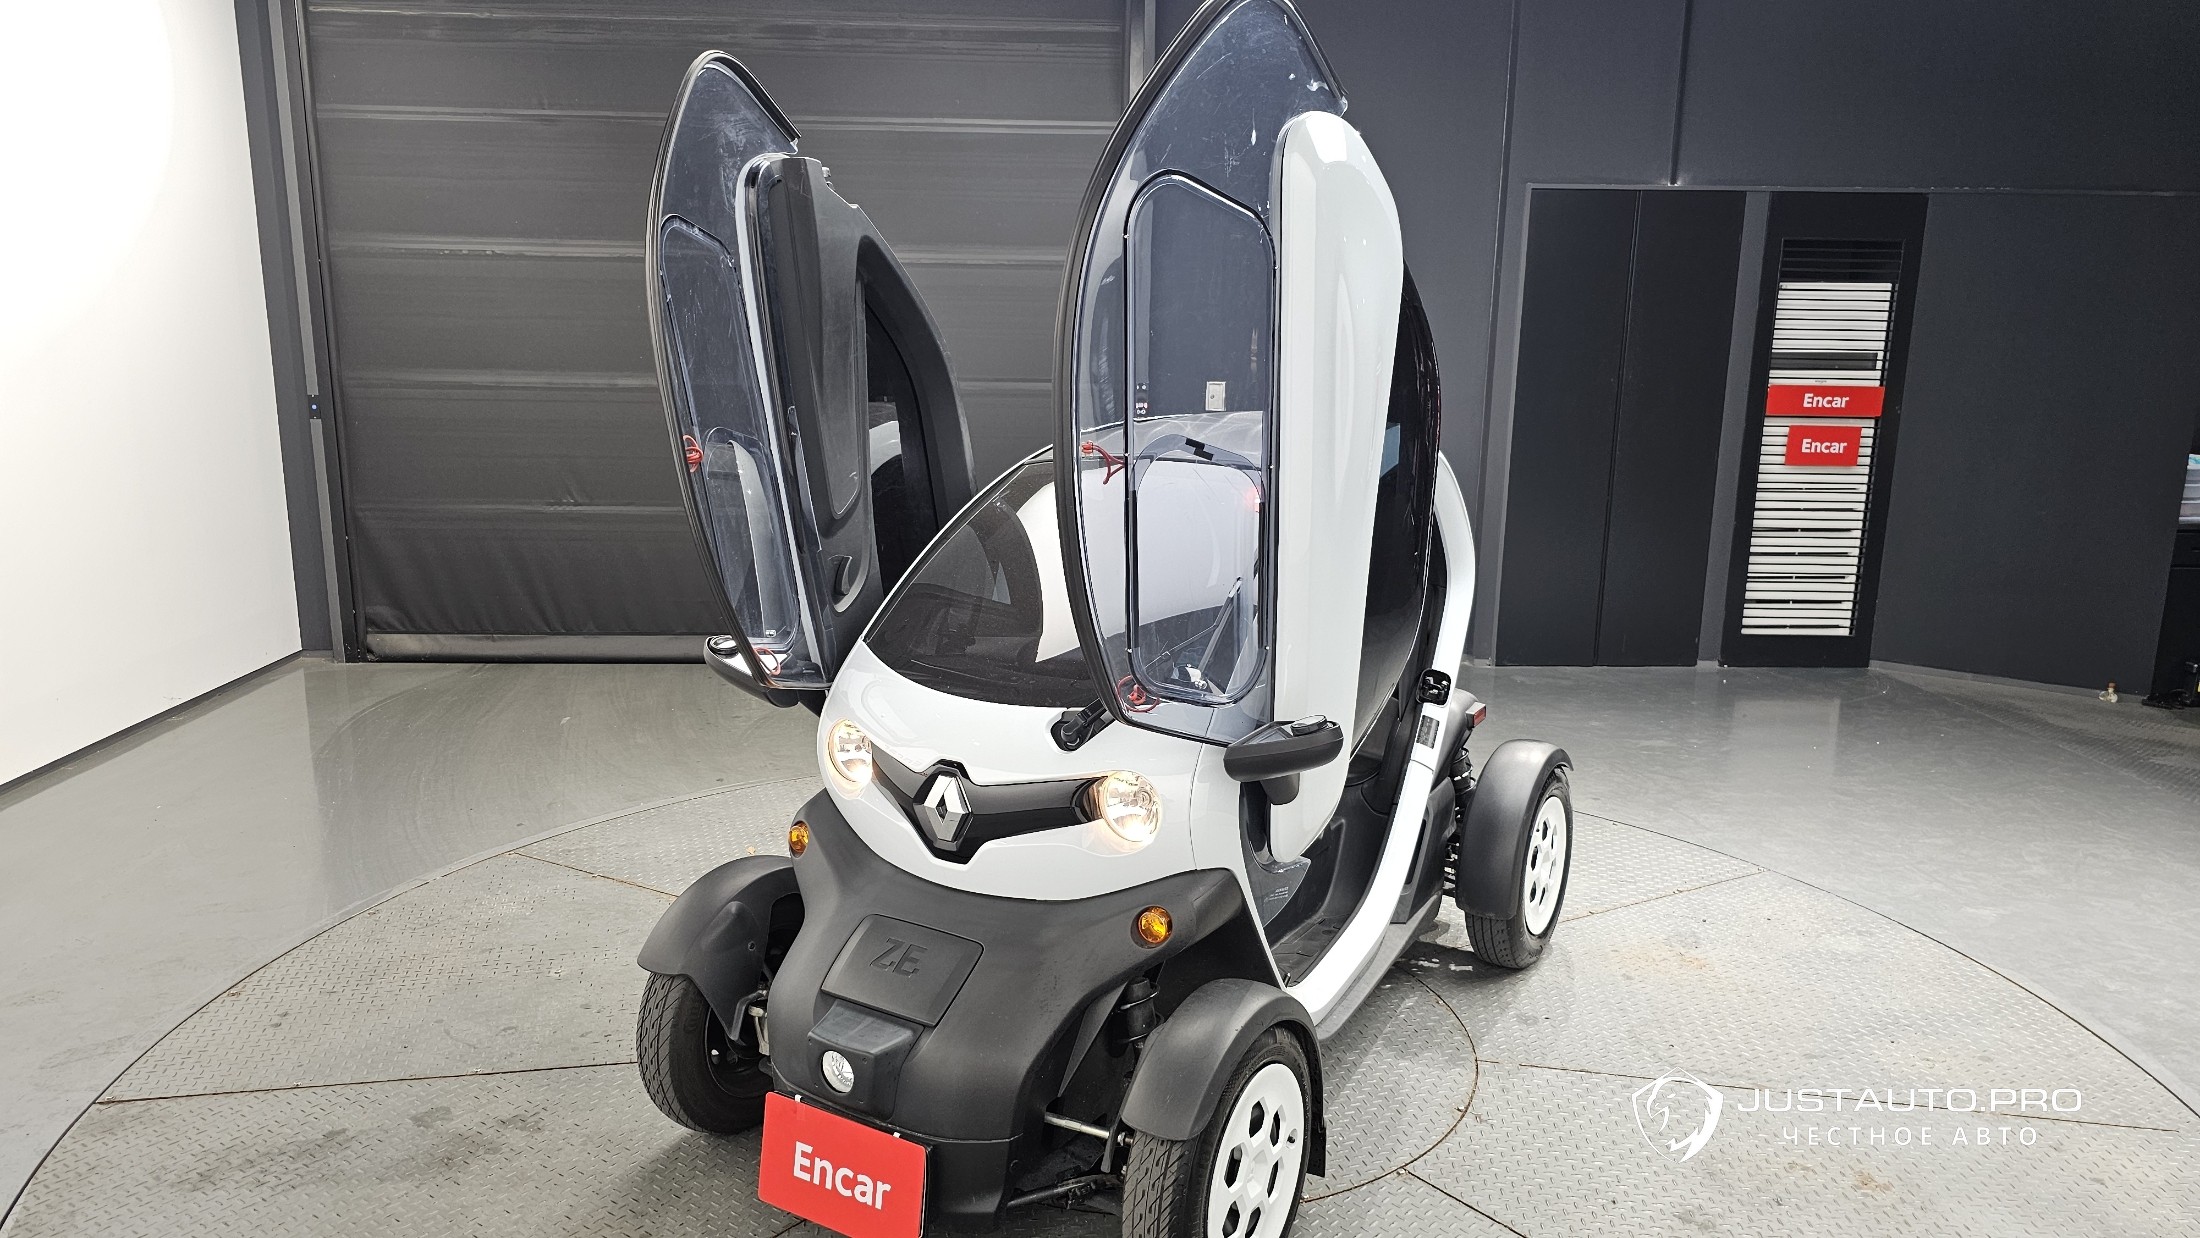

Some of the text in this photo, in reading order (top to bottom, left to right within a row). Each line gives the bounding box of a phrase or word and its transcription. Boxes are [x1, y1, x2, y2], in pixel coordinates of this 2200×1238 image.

[1803, 393, 1849, 408] Encar
[1801, 438, 1847, 453] Encar
[869, 937, 928, 978] ZE
[793, 1141, 891, 1210] Encar
